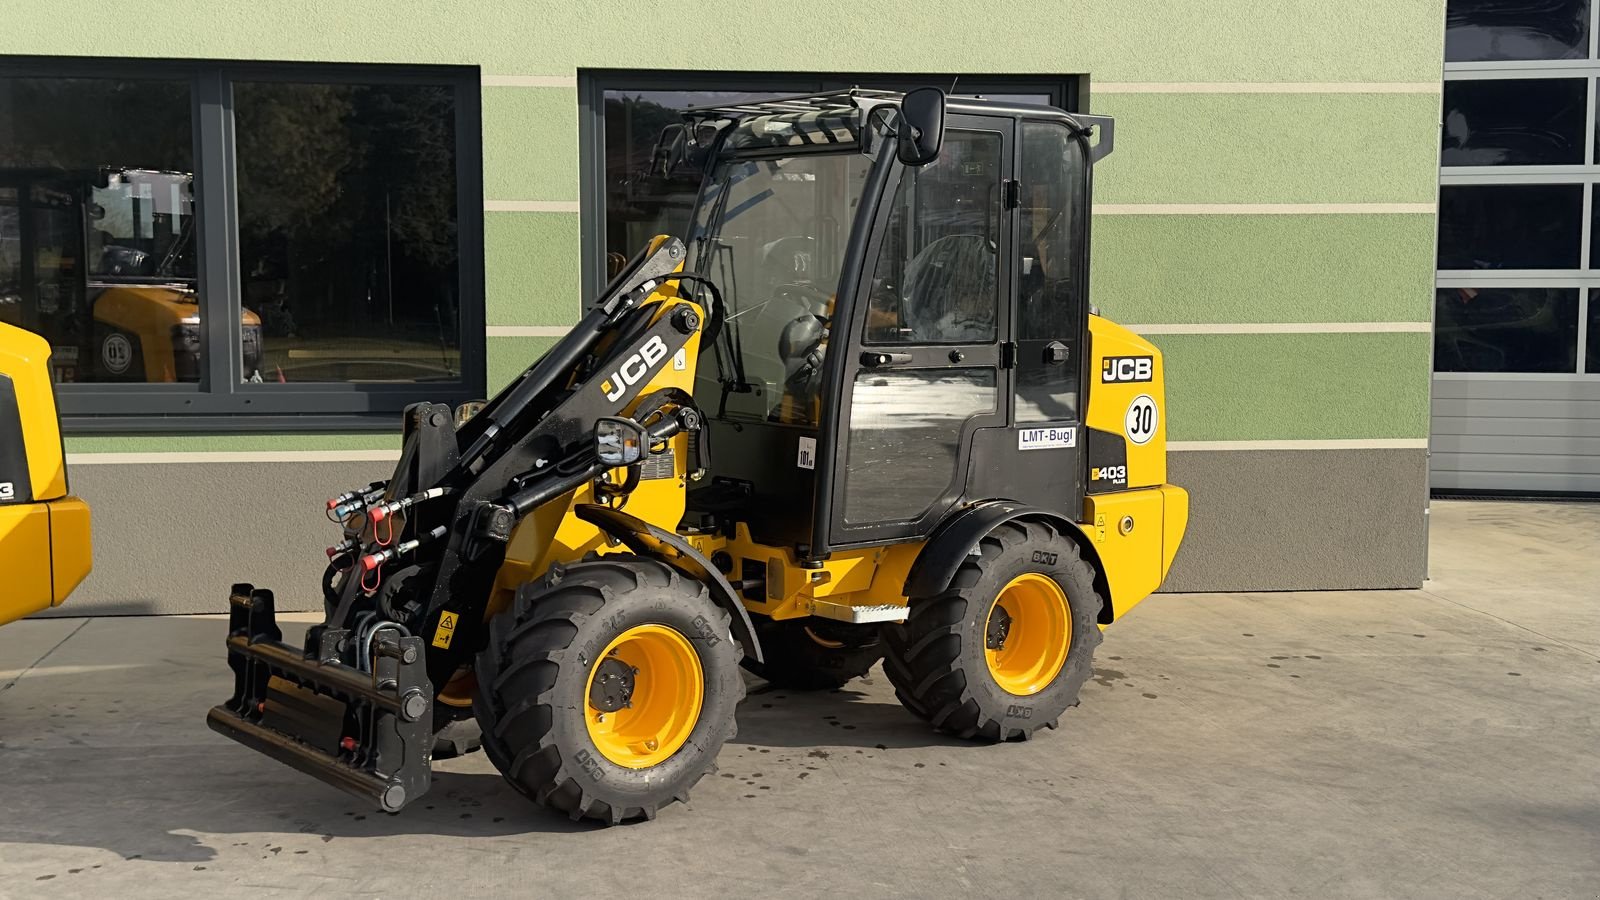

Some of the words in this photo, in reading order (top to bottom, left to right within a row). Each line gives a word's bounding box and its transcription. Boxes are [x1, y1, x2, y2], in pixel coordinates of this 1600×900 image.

[607, 335, 668, 402] JCB
[1103, 358, 1152, 381] JCB
[1131, 405, 1152, 434] 30
[1022, 429, 1073, 443] LMT-Bugl
[1098, 466, 1126, 479] 403
[1032, 551, 1058, 566] BKT
[692, 615, 721, 647] BKT
[1007, 704, 1032, 718] BKT
[575, 749, 605, 782] BKT
